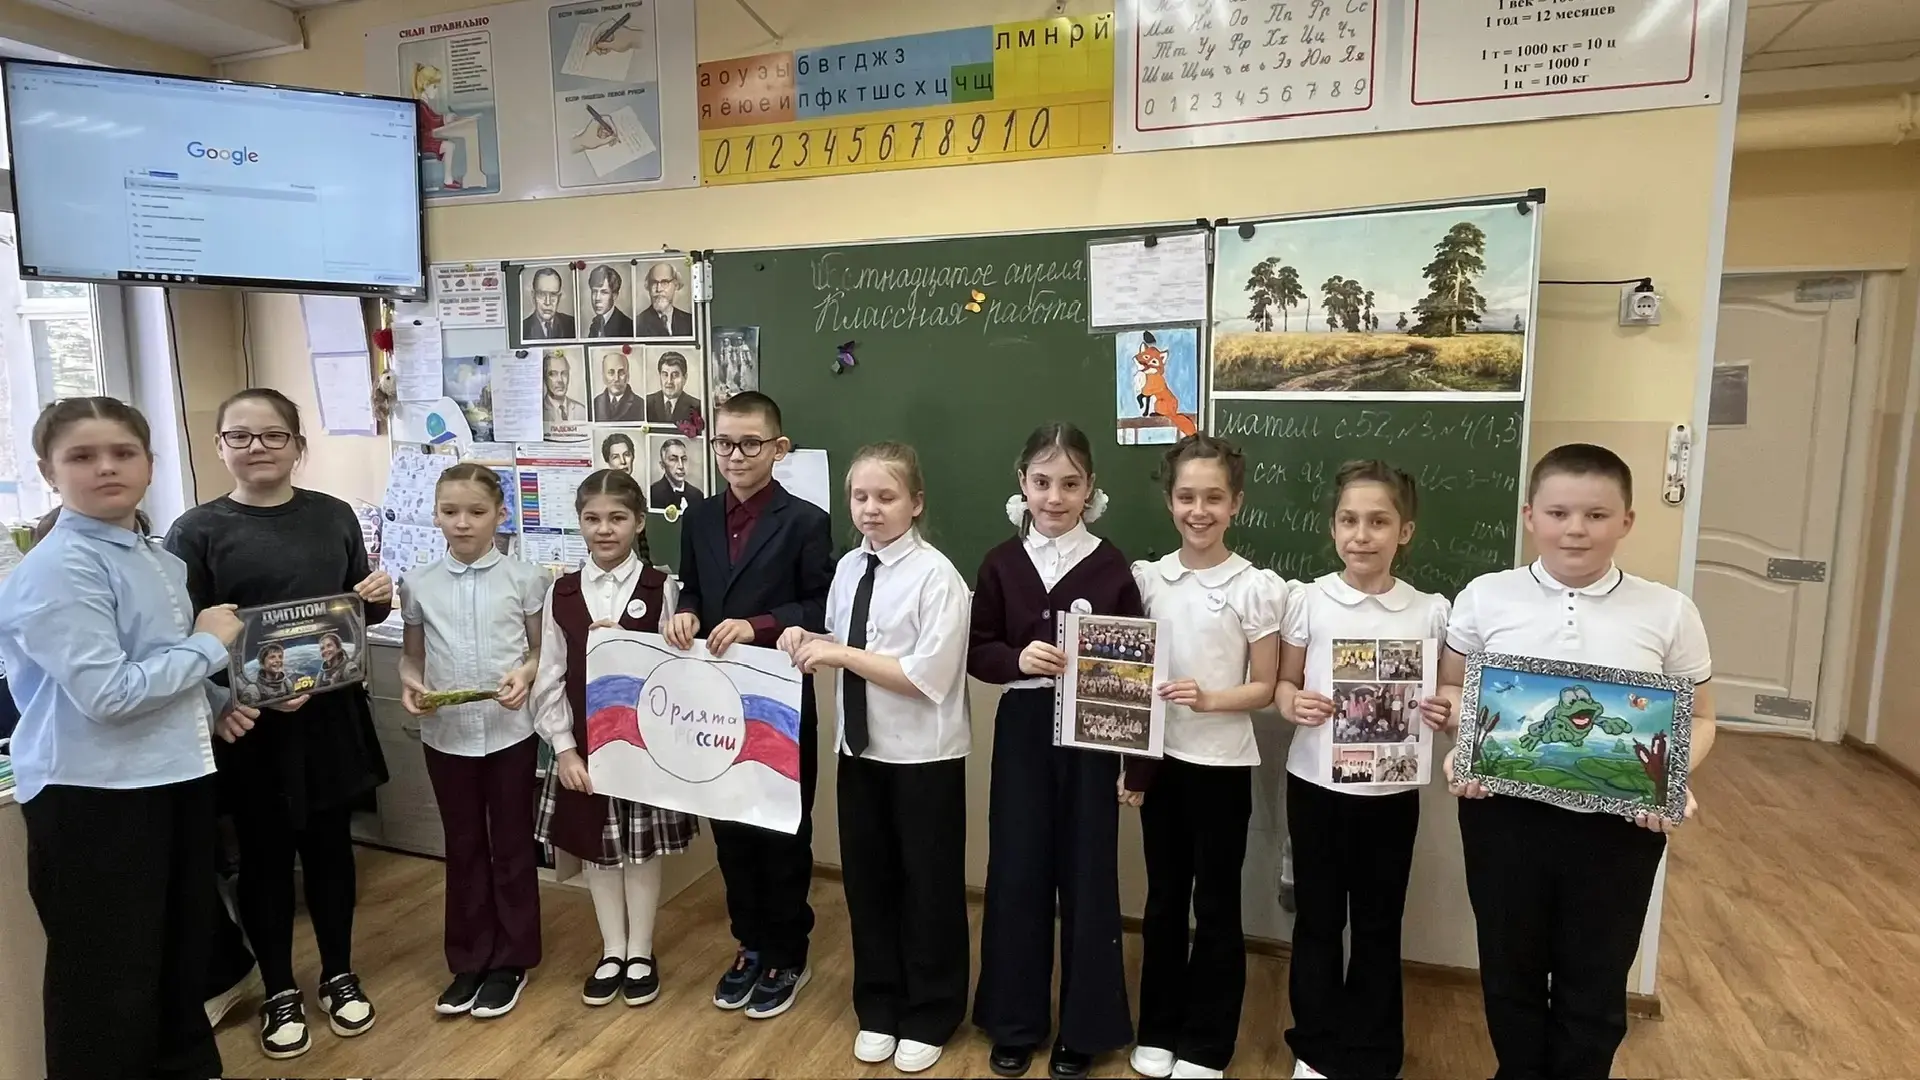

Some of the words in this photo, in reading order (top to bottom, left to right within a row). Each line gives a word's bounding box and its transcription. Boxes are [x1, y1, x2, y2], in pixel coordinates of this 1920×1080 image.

[1229, 8, 1248, 26] Оо
[1264, 3, 1292, 24] Пп
[1308, 0, 1331, 21] Рр
[1486, 16, 1491, 27] 1
[1497, 16, 1518, 27] год
[1537, 10, 1551, 22] 12
[1556, 5, 1616, 20] месяцев
[399, 27, 425, 38] СИДИ
[430, 17, 490, 33] ПРАВИЛЬНО
[1152, 40, 1187, 60] Тт
[1197, 37, 1217, 60] Уу
[1228, 33, 1251, 58] Фф
[1262, 28, 1289, 47] Хх
[1300, 25, 1325, 44] Цц
[1338, 20, 1355, 38] Чч
[1482, 50, 1486, 60] 1
[1492, 51, 1500, 59] т
[1517, 43, 1548, 57] 1000
[1552, 44, 1569, 53] кг
[1587, 37, 1602, 50] 10
[1607, 39, 1616, 49] ц
[1141, 66, 1174, 83] Шш
[1181, 61, 1214, 81] Щщ
[1273, 51, 1292, 69] Ээ
[1300, 48, 1331, 67] Юю
[1339, 45, 1365, 63] Яя
[1504, 63, 1508, 74] 1
[1514, 63, 1531, 73] кг
[1548, 56, 1579, 70] 1000
[1584, 58, 1591, 67] г
[1504, 79, 1508, 90] 1
[1514, 80, 1523, 90] ц
[1545, 73, 1568, 86] 100
[1572, 74, 1589, 84] кг
[1144, 98, 1155, 116] 0
[1170, 96, 1177, 112] 1
[1190, 94, 1200, 111] 2
[1212, 91, 1222, 109] 3
[1235, 90, 1245, 106] 4
[1256, 86, 1269, 104] 5
[1281, 85, 1292, 102] 6
[1306, 82, 1317, 100] 7
[1331, 81, 1341, 98] 8
[1354, 78, 1366, 95] 9
[187, 141, 259, 166] Google
[1003, 259, 1087, 305] апреля.
[813, 292, 967, 332] Классная
[983, 290, 1086, 336] работа.
[262, 602, 327, 626] ДИПЛОМ
[649, 685, 737, 725] Орлята
